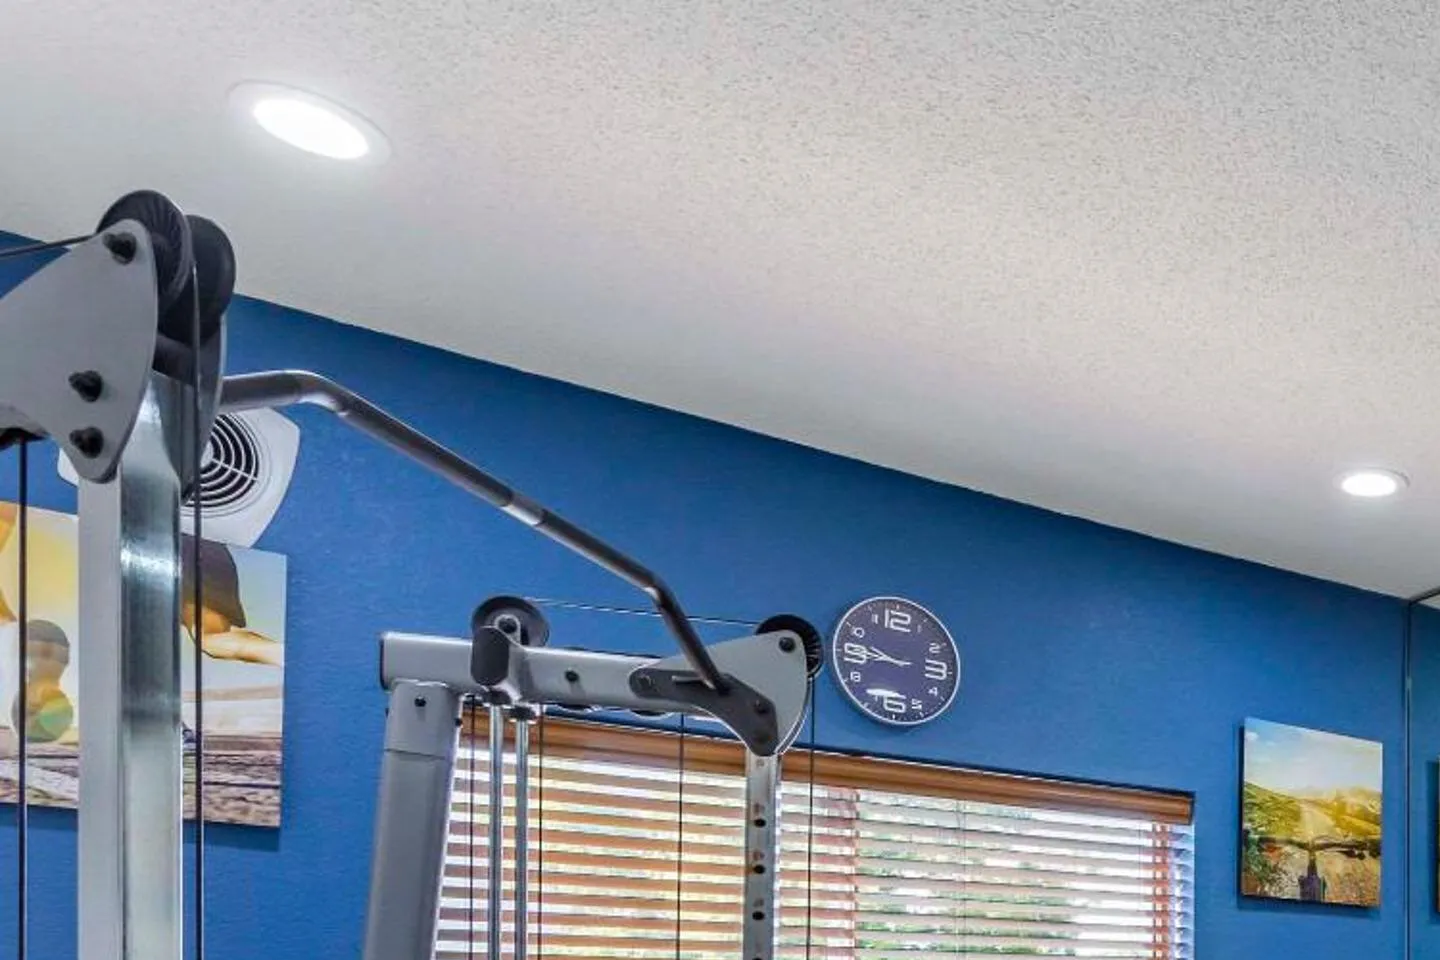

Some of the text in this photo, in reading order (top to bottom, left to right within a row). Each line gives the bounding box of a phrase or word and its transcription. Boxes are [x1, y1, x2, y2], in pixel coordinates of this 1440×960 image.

[884, 608, 911, 633] 12
[844, 642, 867, 664] 9
[925, 659, 947, 681] 3
[883, 691, 907, 713] 6
